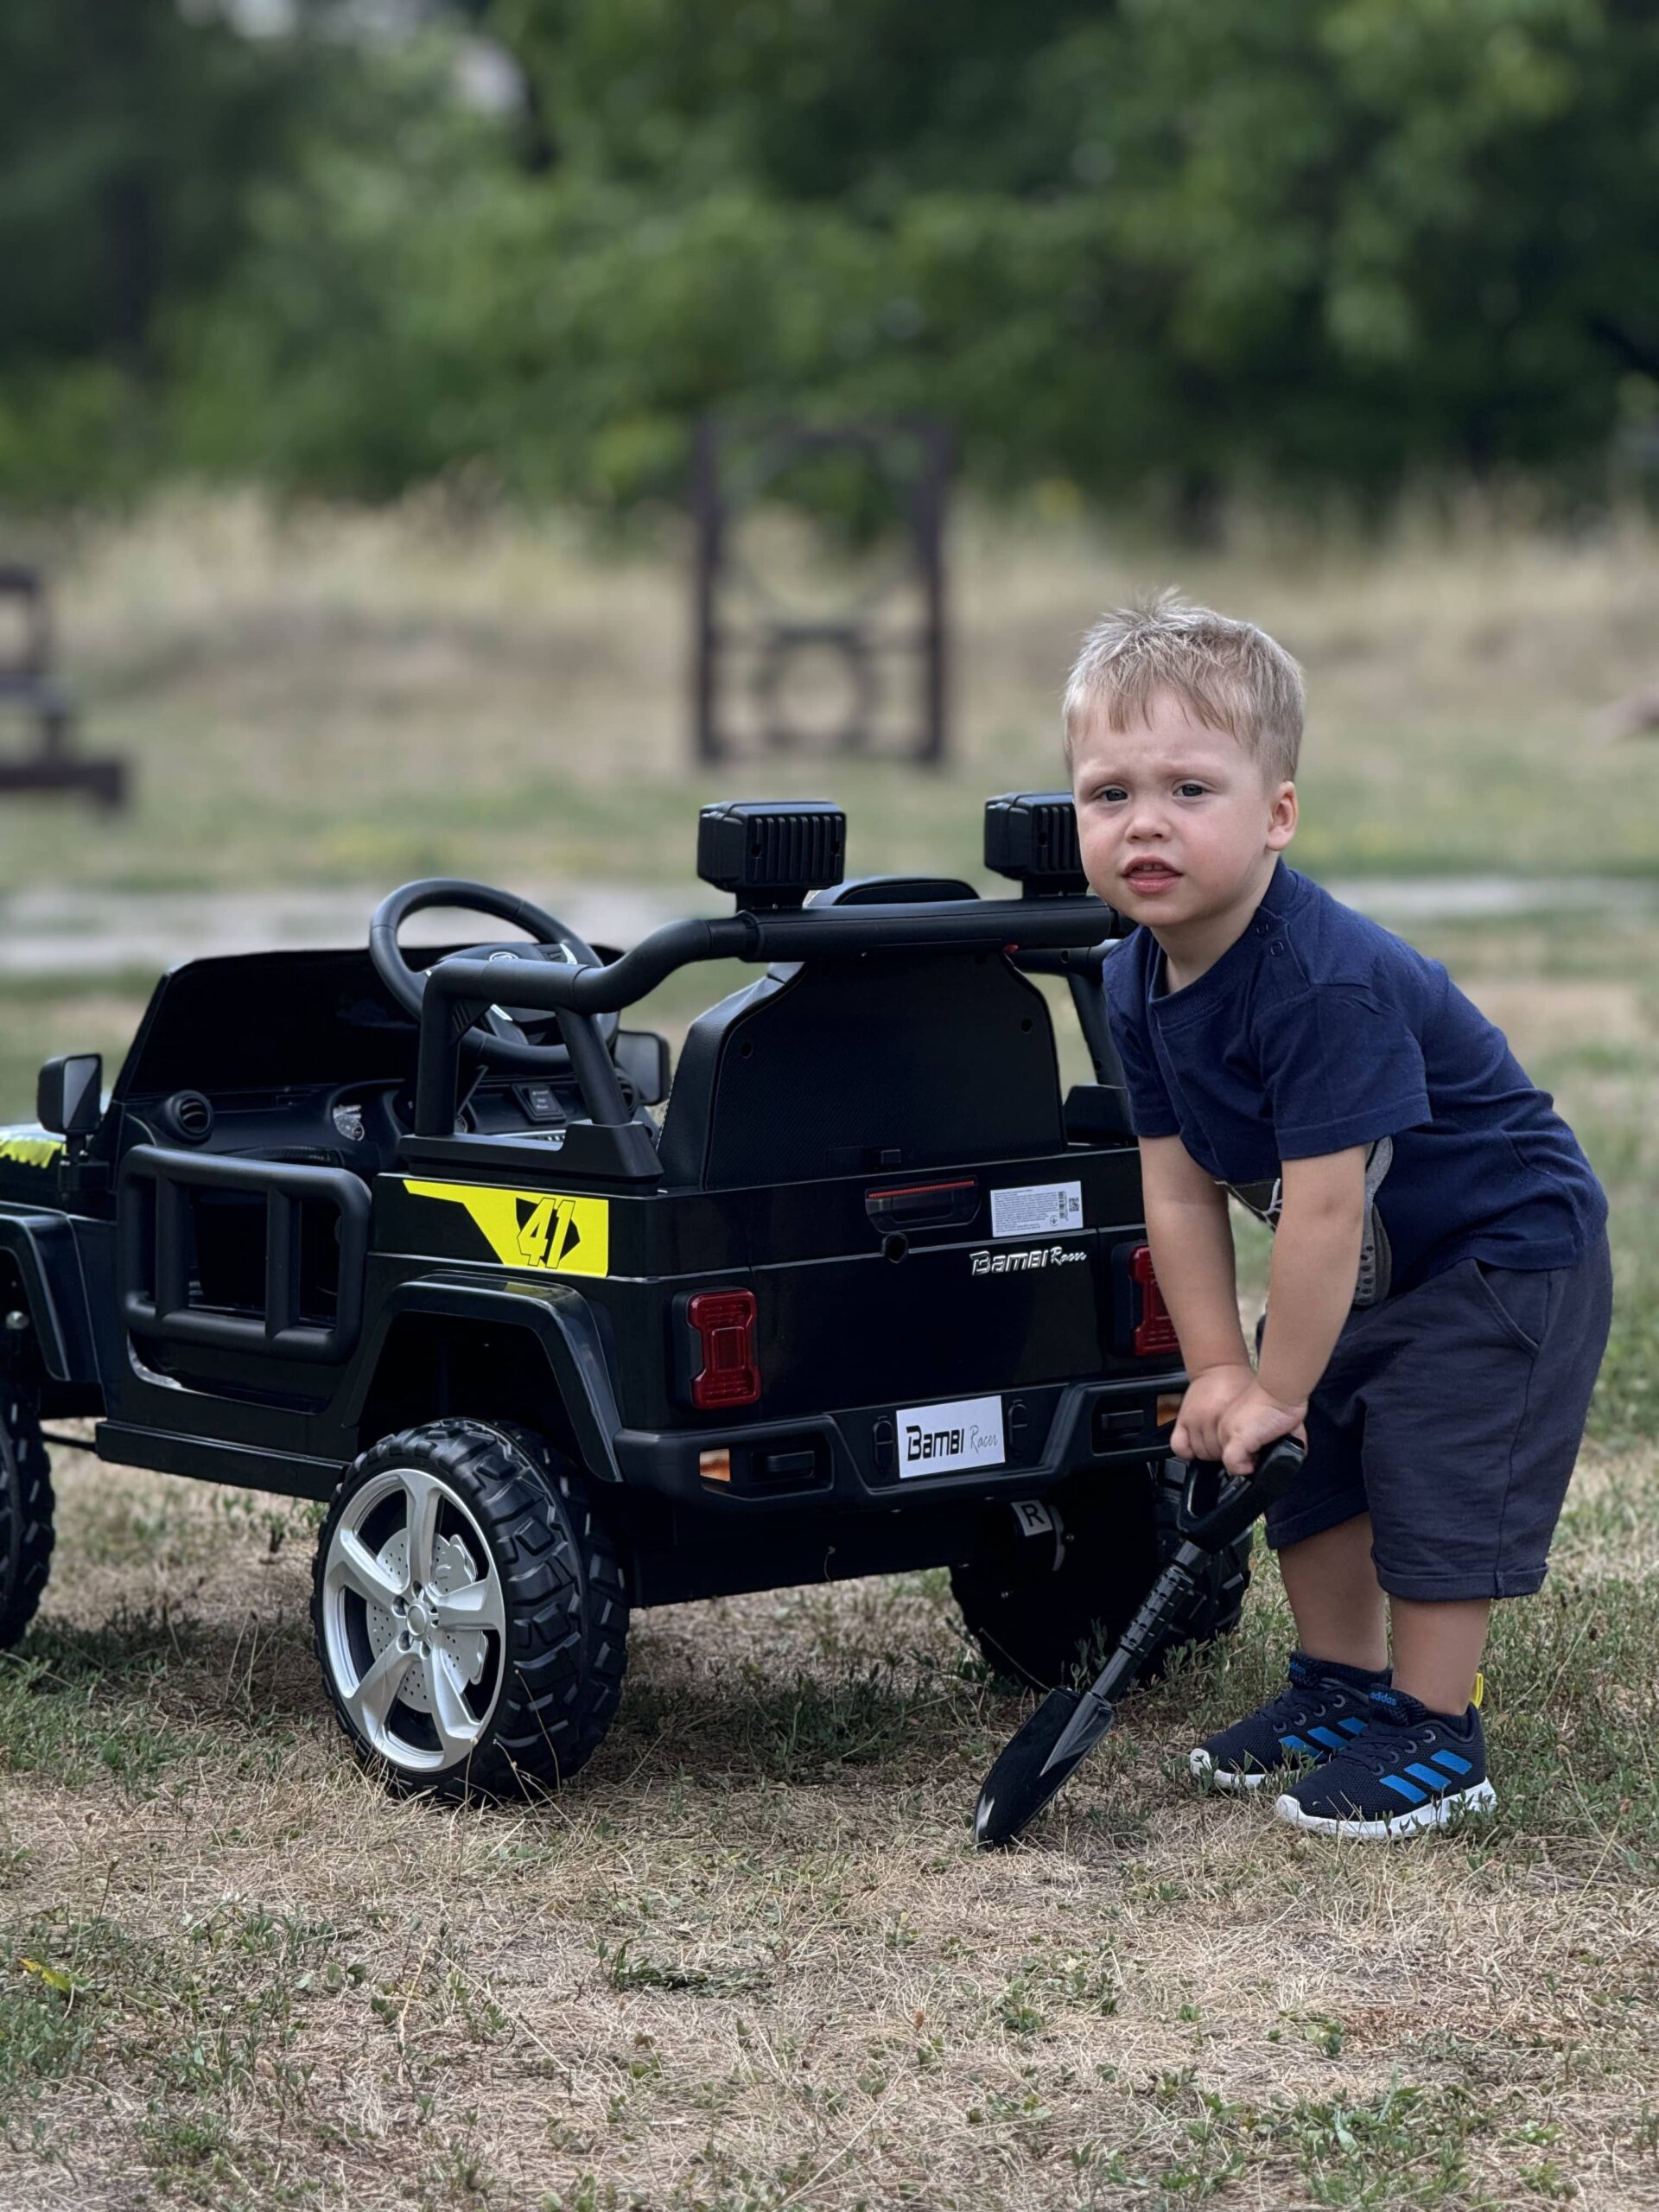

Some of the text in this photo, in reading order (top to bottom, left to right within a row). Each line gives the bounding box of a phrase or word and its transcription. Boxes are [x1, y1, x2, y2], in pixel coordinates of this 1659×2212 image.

[517, 1197, 576, 1269] 41
[969, 1424, 998, 1453] Racer
[1020, 1503, 1046, 1528] R
[1370, 1692, 1397, 1707] adidas
